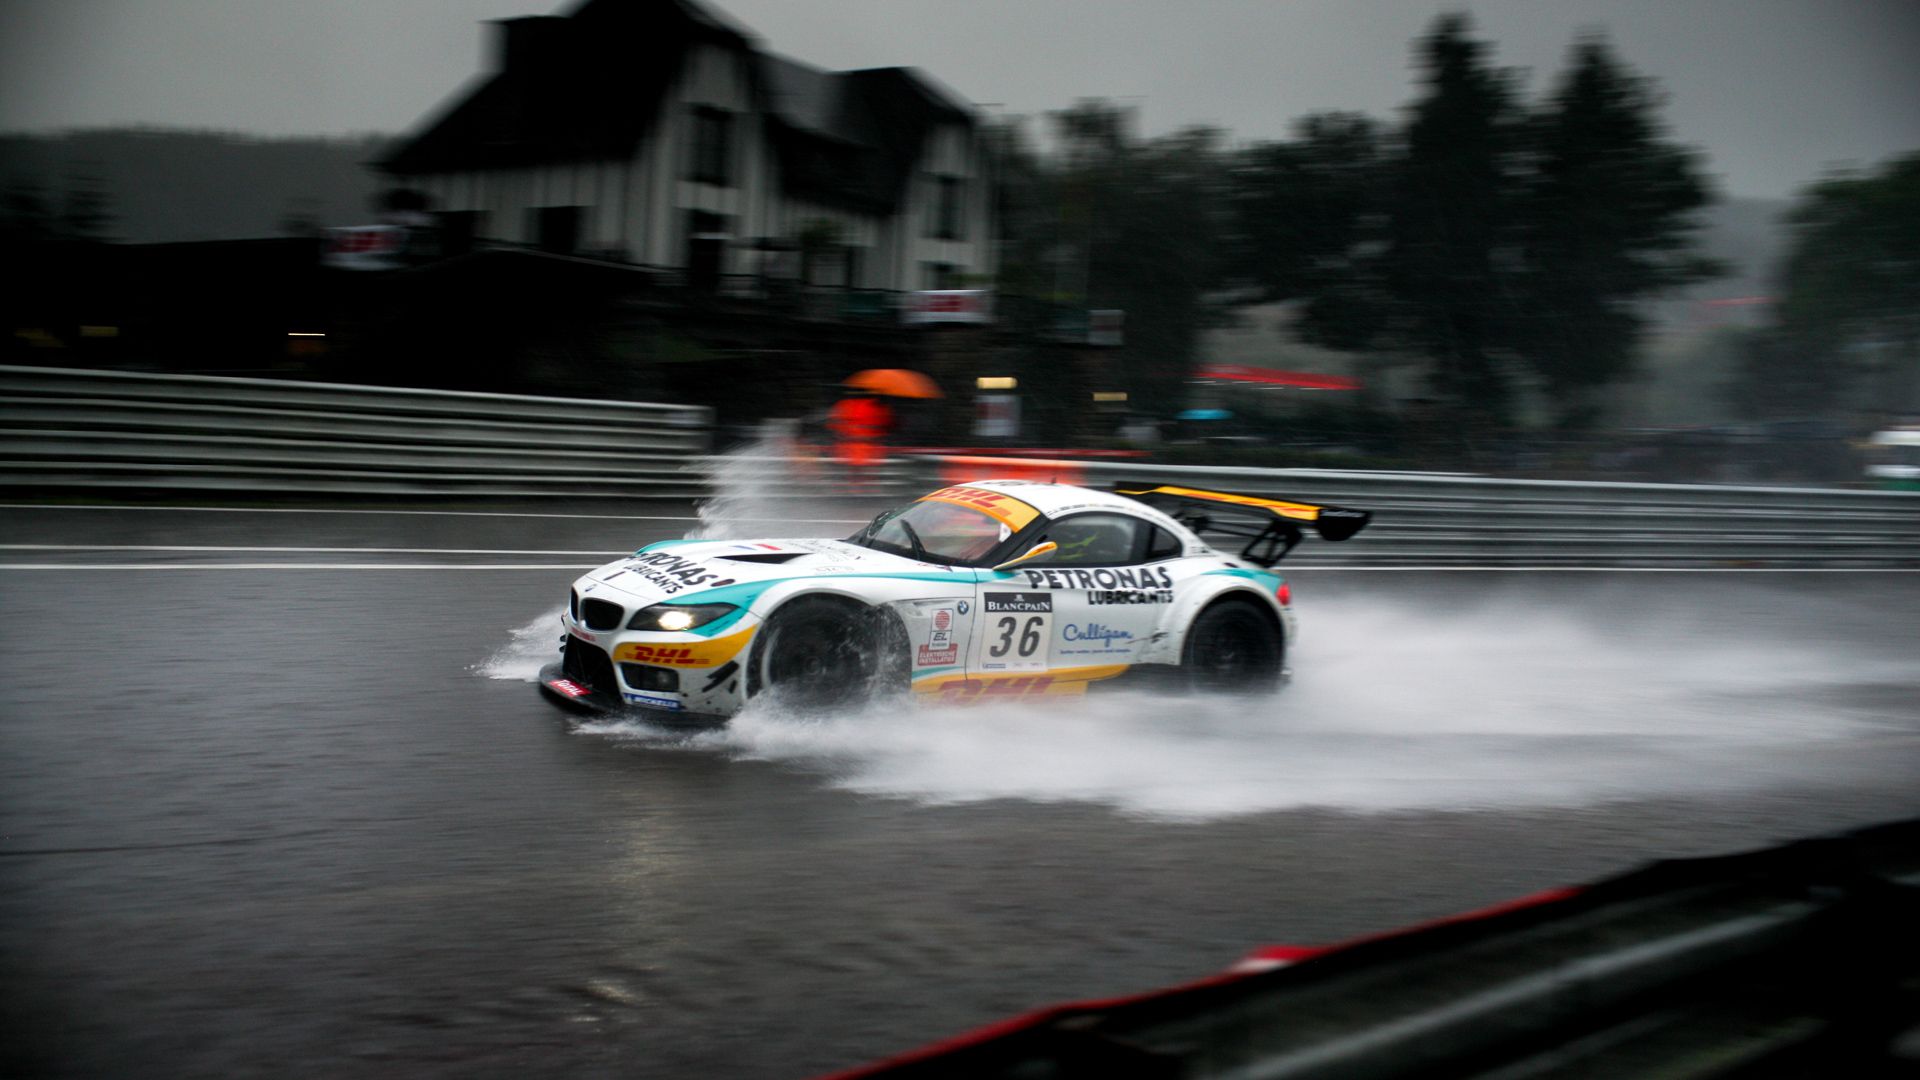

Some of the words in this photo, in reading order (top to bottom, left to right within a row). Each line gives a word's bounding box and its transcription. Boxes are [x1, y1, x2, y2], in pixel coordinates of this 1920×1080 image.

[932, 487, 1006, 508] DHL
[1024, 566, 1172, 590] PETRONAS
[987, 601, 1050, 611] BLANCPAIN
[1087, 590, 1174, 605] LUBRICANTS
[989, 616, 1044, 657] 36
[1062, 622, 1132, 648] Culligan
[634, 645, 696, 665] DHL
[937, 676, 1060, 704] DHL
